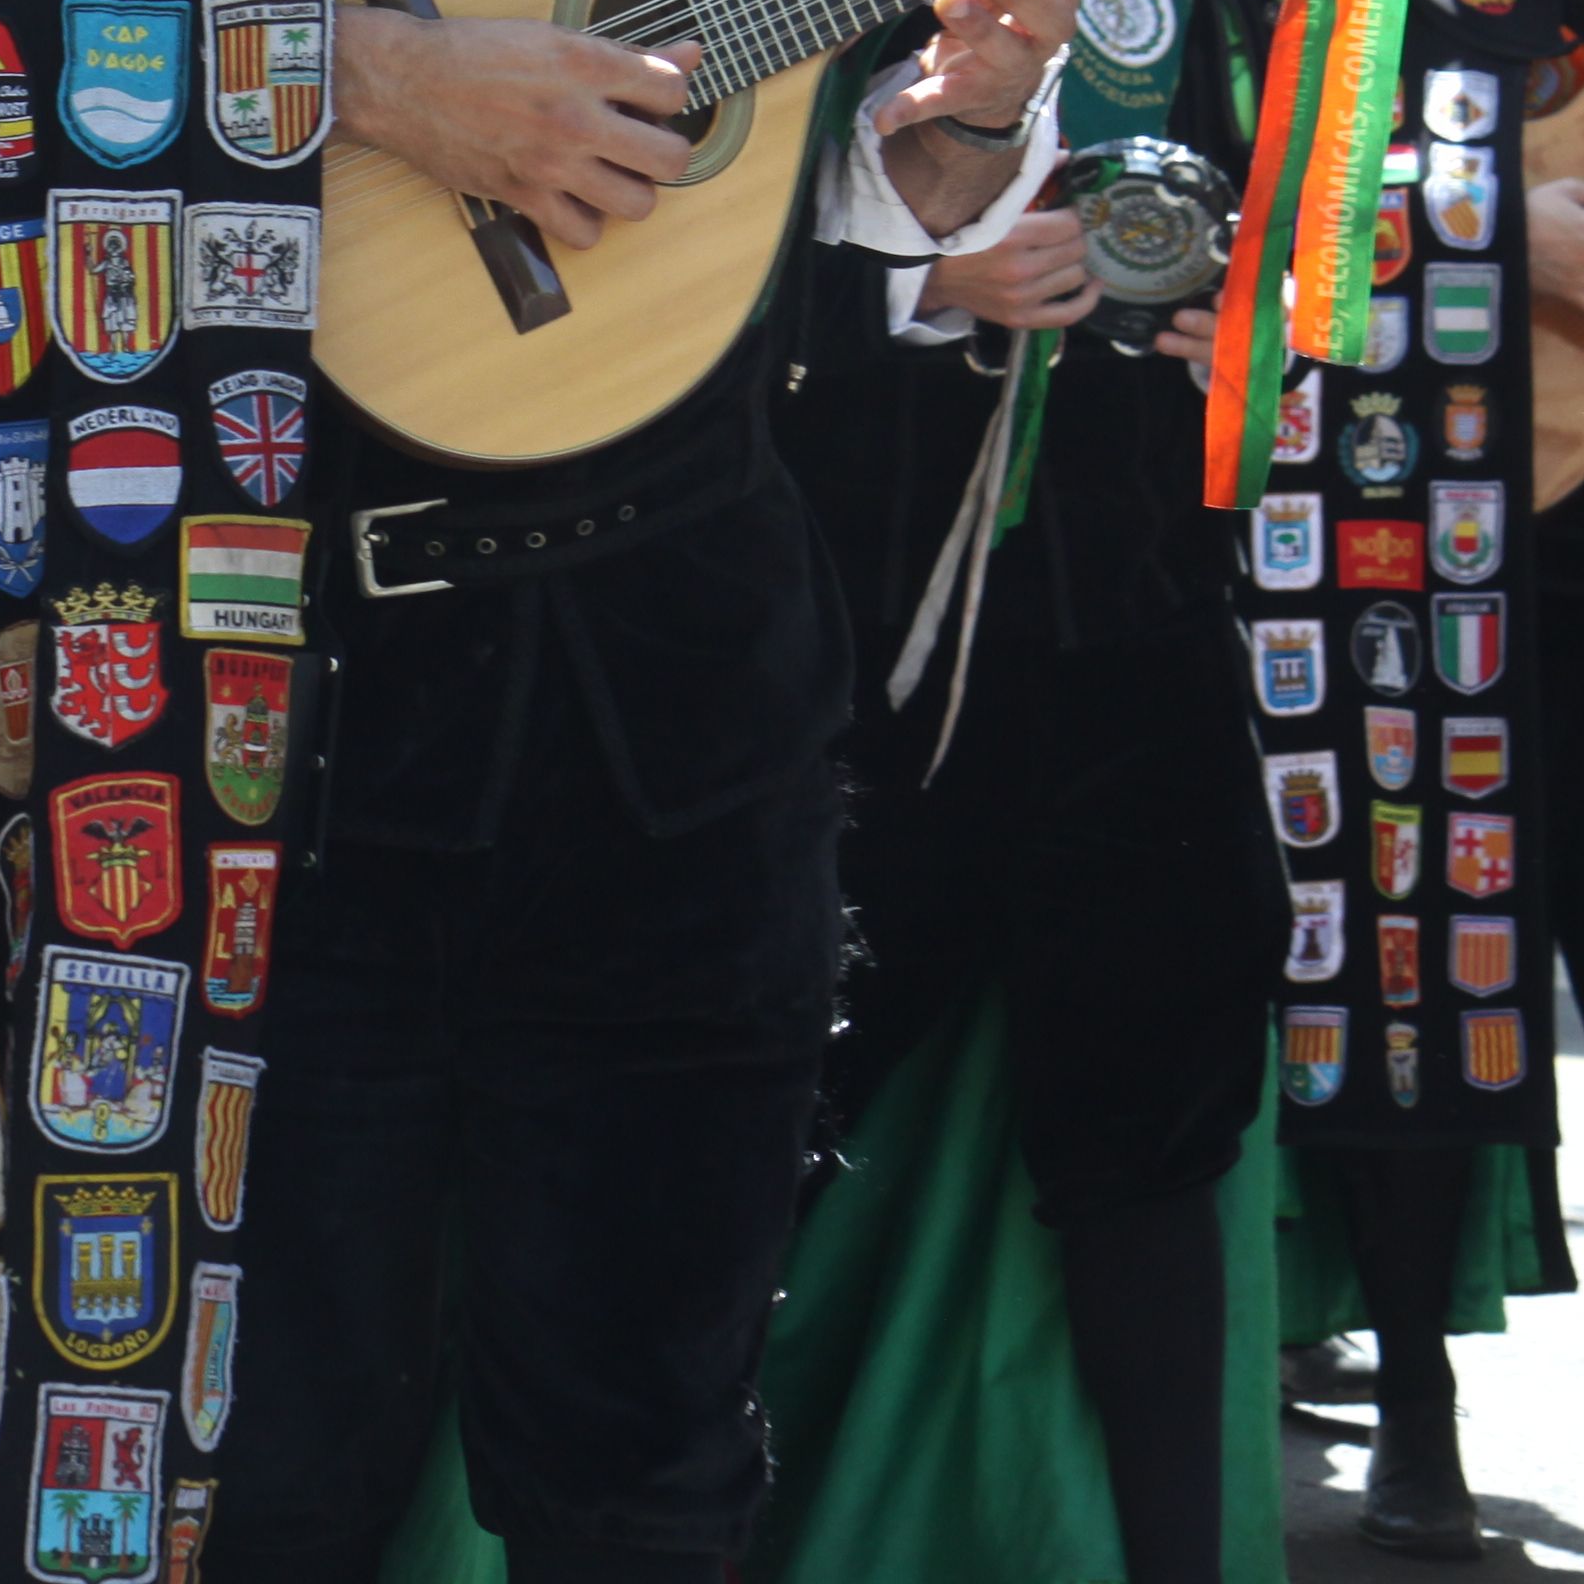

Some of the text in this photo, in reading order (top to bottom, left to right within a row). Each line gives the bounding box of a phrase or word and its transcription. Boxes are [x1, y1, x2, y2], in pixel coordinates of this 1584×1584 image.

[102, 25, 149, 43] CAP
[1316, 100, 1376, 300] ECONÓMICAS,
[73, 406, 178, 434] NEDERLAND
[71, 787, 164, 809] VALENCIA
[64, 962, 166, 991] SEVILLA
[65, 1327, 150, 1359] LOGROÑO
[53, 1399, 76, 1413] Las
